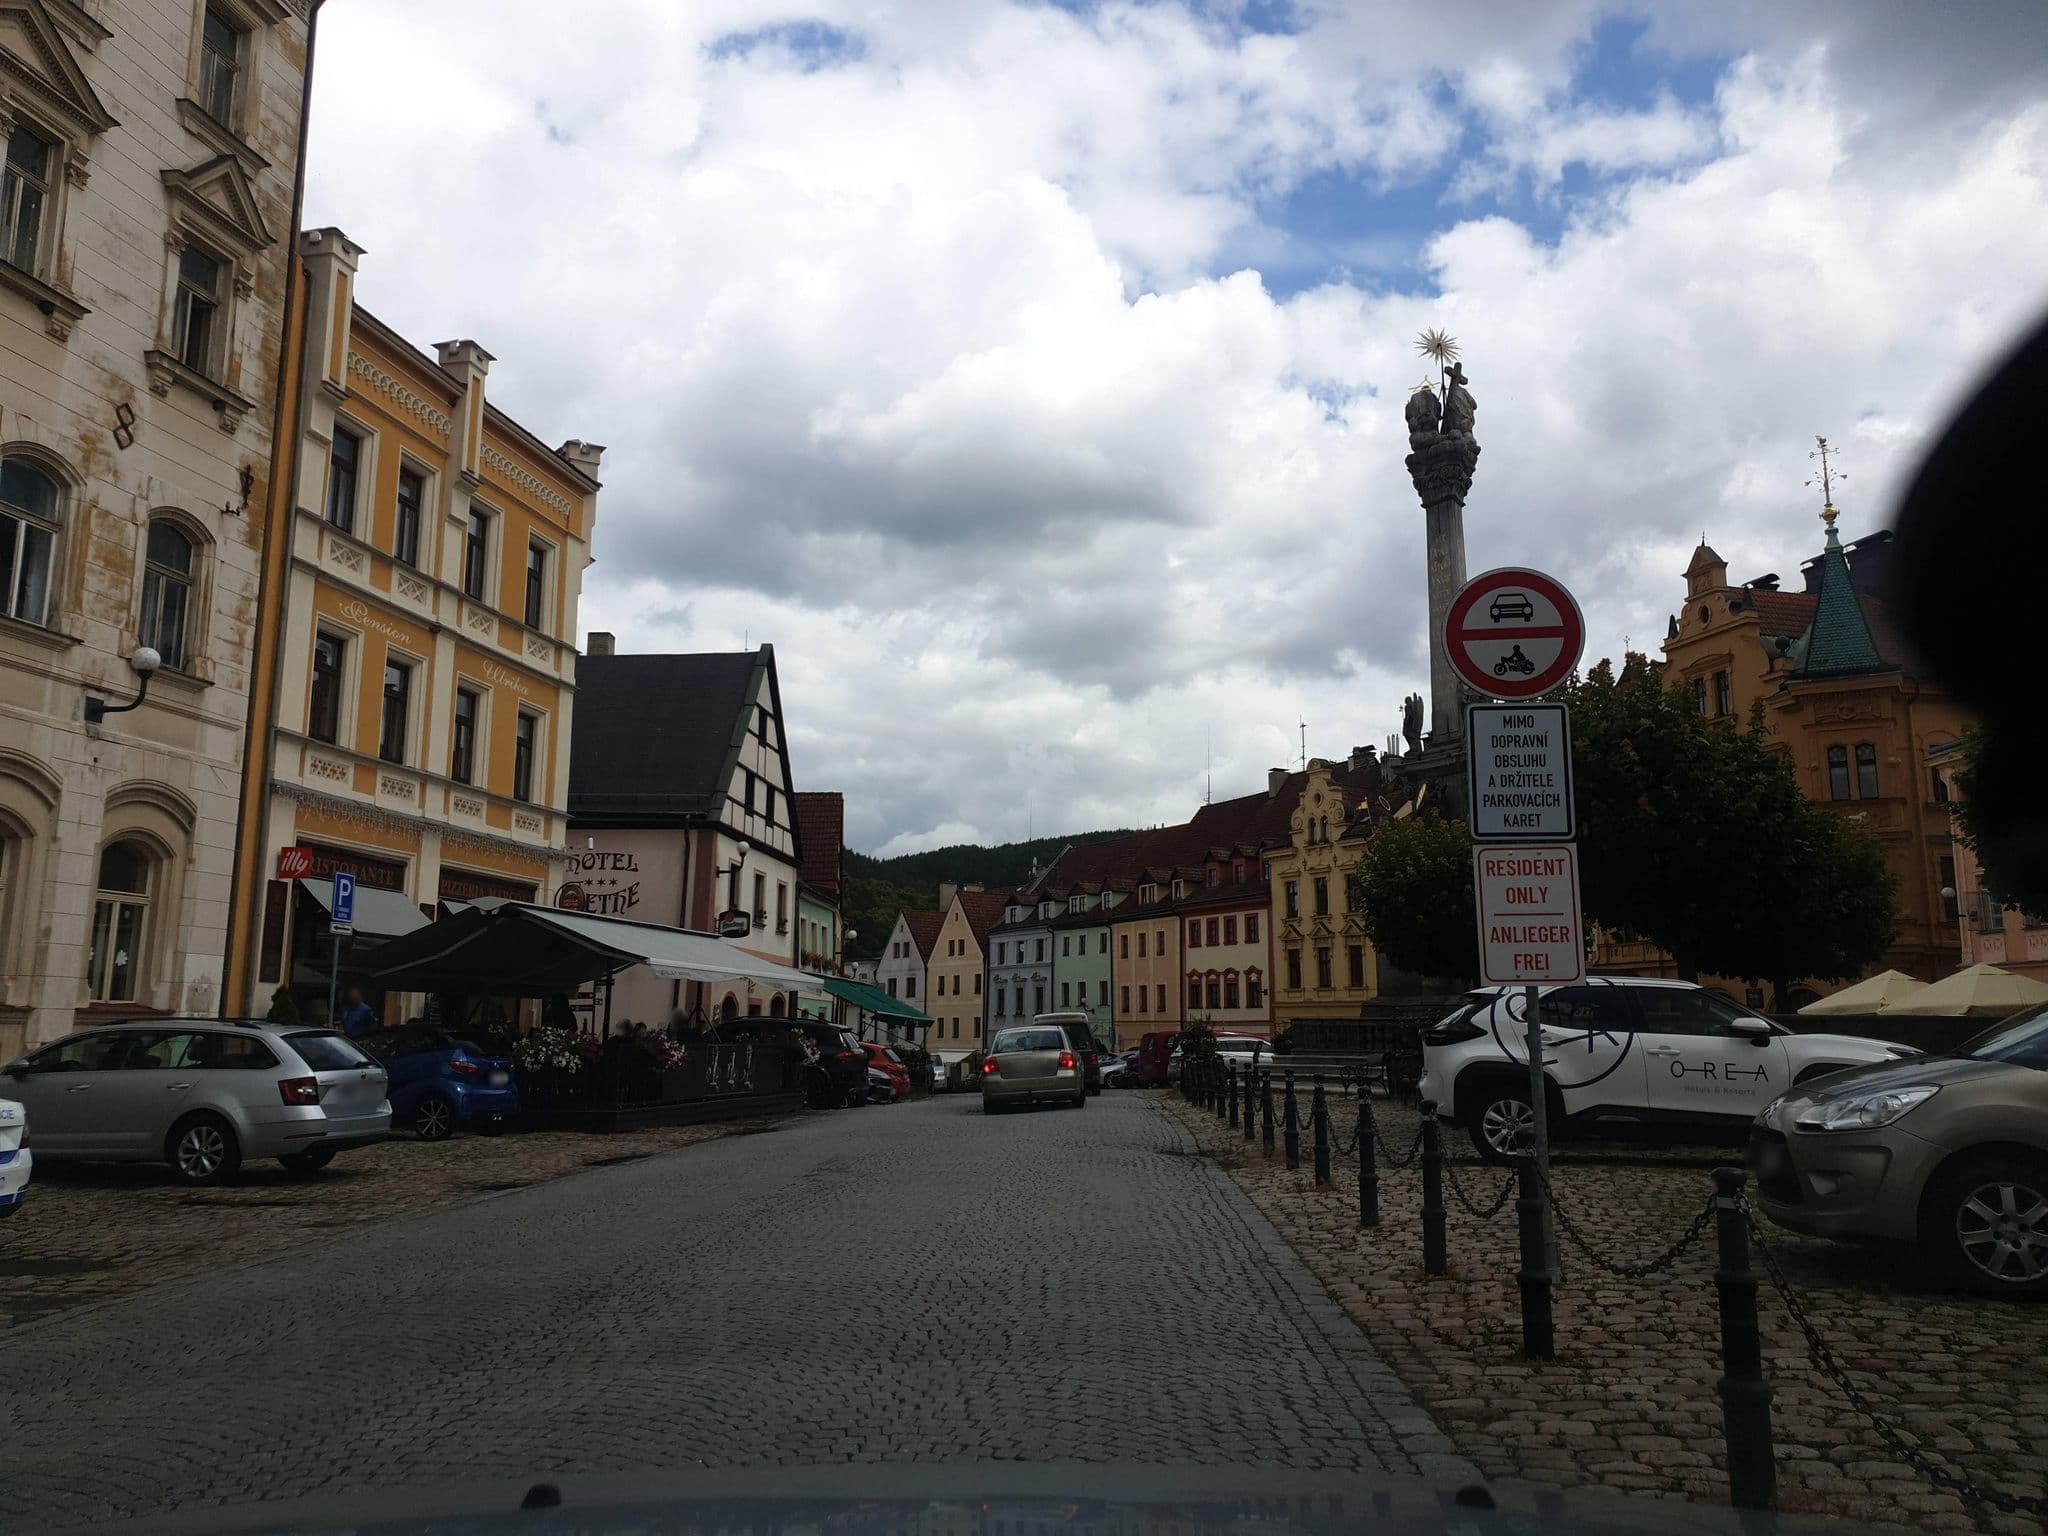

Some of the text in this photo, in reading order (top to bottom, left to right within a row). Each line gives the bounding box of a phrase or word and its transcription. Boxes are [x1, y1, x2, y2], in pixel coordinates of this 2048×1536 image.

[339, 600, 412, 644] Pension
[1503, 715, 1534, 729] MIMO
[1491, 731, 1548, 748] DOPRAVNÍ
[1494, 754, 1546, 768] OBSLUHU
[1488, 771, 1554, 788] A DRŽITELE
[1483, 790, 1561, 808] PARKOVACÍCH
[1503, 813, 1542, 828] KARET
[281, 851, 309, 876] illy
[565, 852, 639, 875] HOTEL
[1486, 858, 1565, 877] RESIDENT
[338, 879, 352, 906] P
[1506, 886, 1548, 904] ONLY
[1490, 926, 1570, 944] ANLIEGER
[1513, 953, 1549, 971] FREI
[1670, 1060, 1769, 1083] OREA
